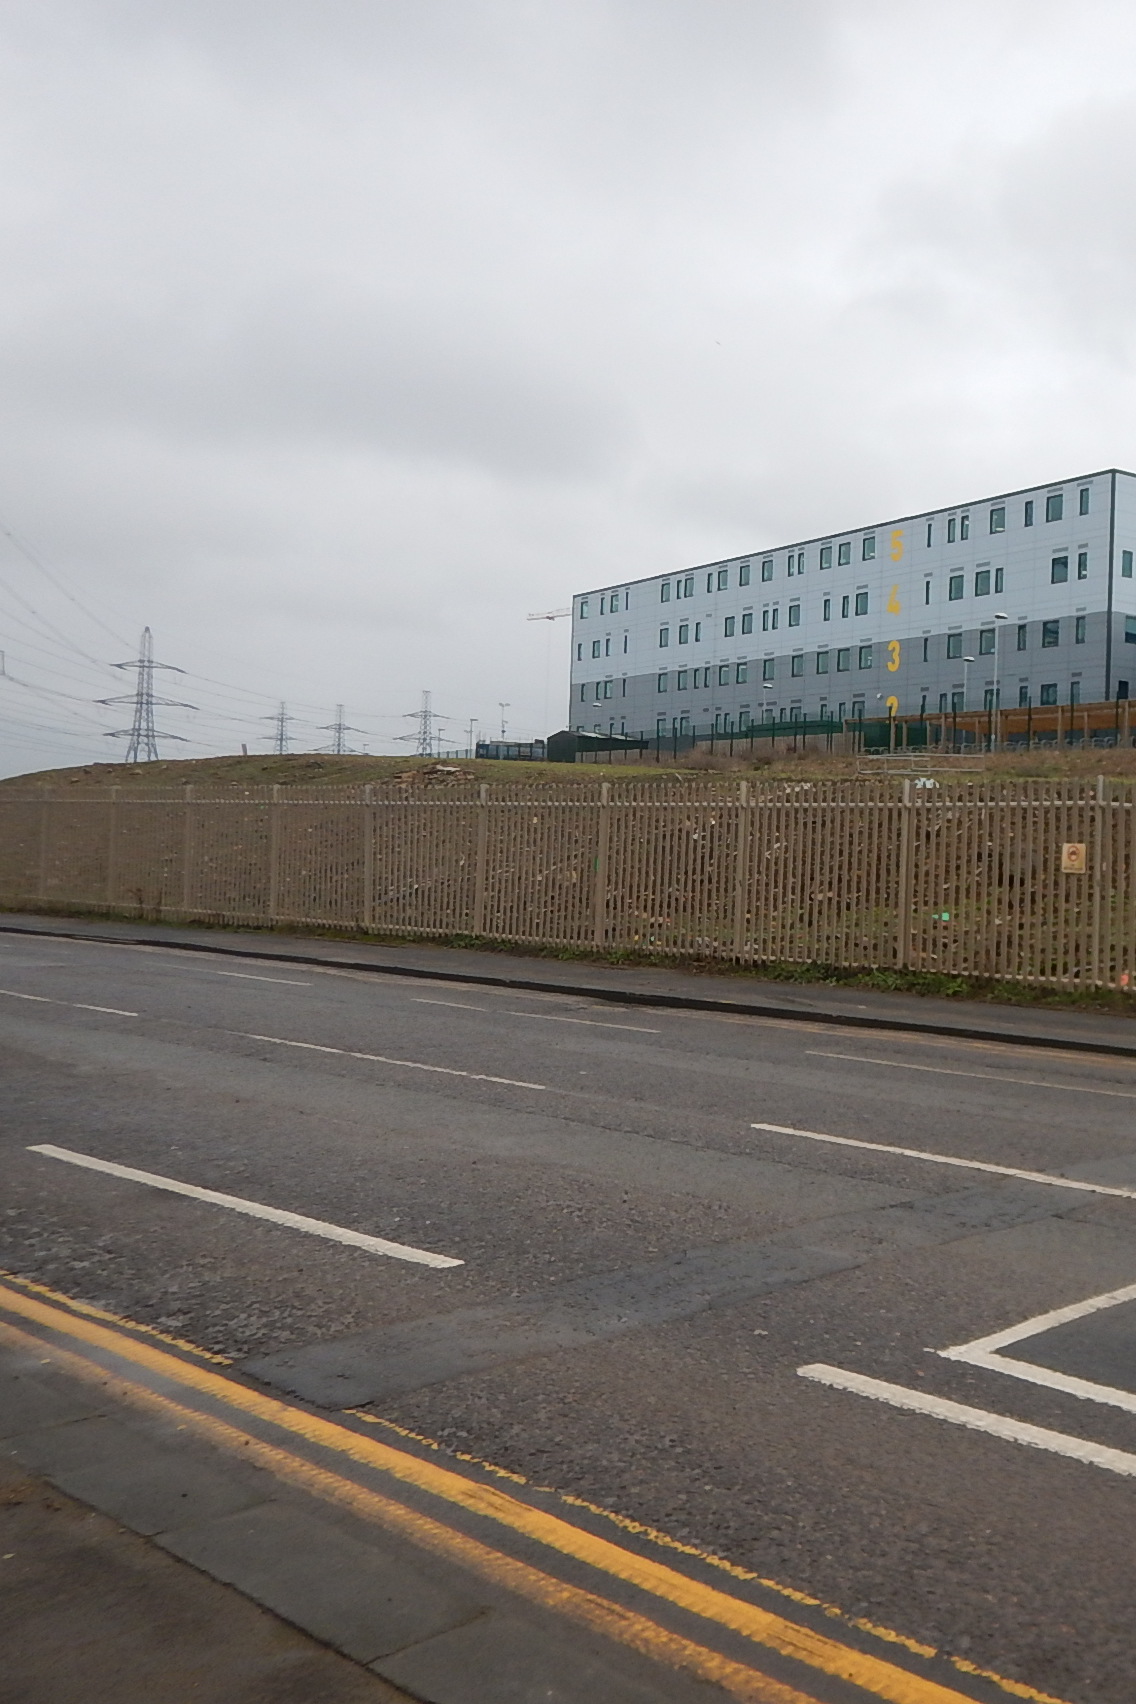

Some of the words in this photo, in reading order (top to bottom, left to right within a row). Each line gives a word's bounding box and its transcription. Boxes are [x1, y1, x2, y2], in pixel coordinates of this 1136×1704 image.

[890, 530, 903, 562] 5
[887, 585, 901, 615] 4
[887, 640, 900, 672] 3
